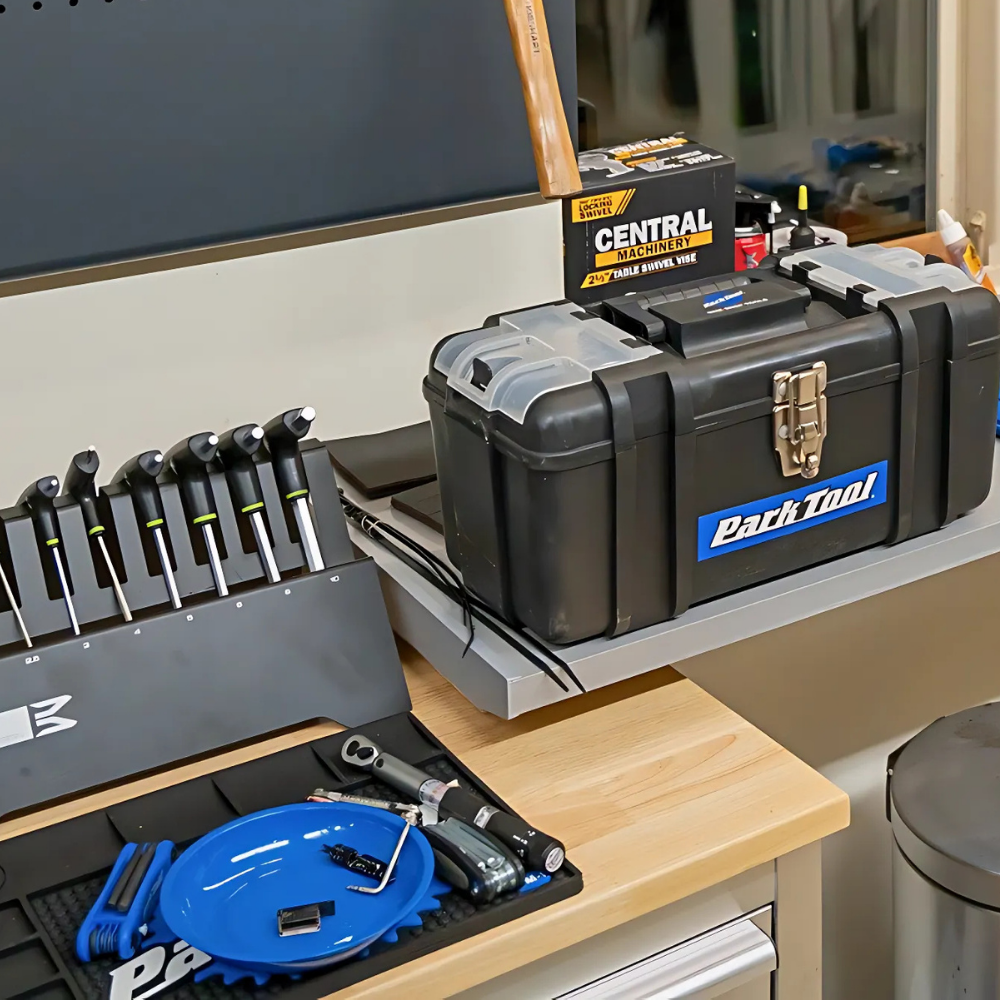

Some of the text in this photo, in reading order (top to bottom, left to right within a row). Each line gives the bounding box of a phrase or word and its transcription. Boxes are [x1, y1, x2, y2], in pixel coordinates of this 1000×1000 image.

[594, 208, 713, 253] CENTRAL
[617, 236, 692, 262] MACHINERY
[641, 257, 675, 273] SWIVEL
[710, 471, 880, 549] Park Tool
